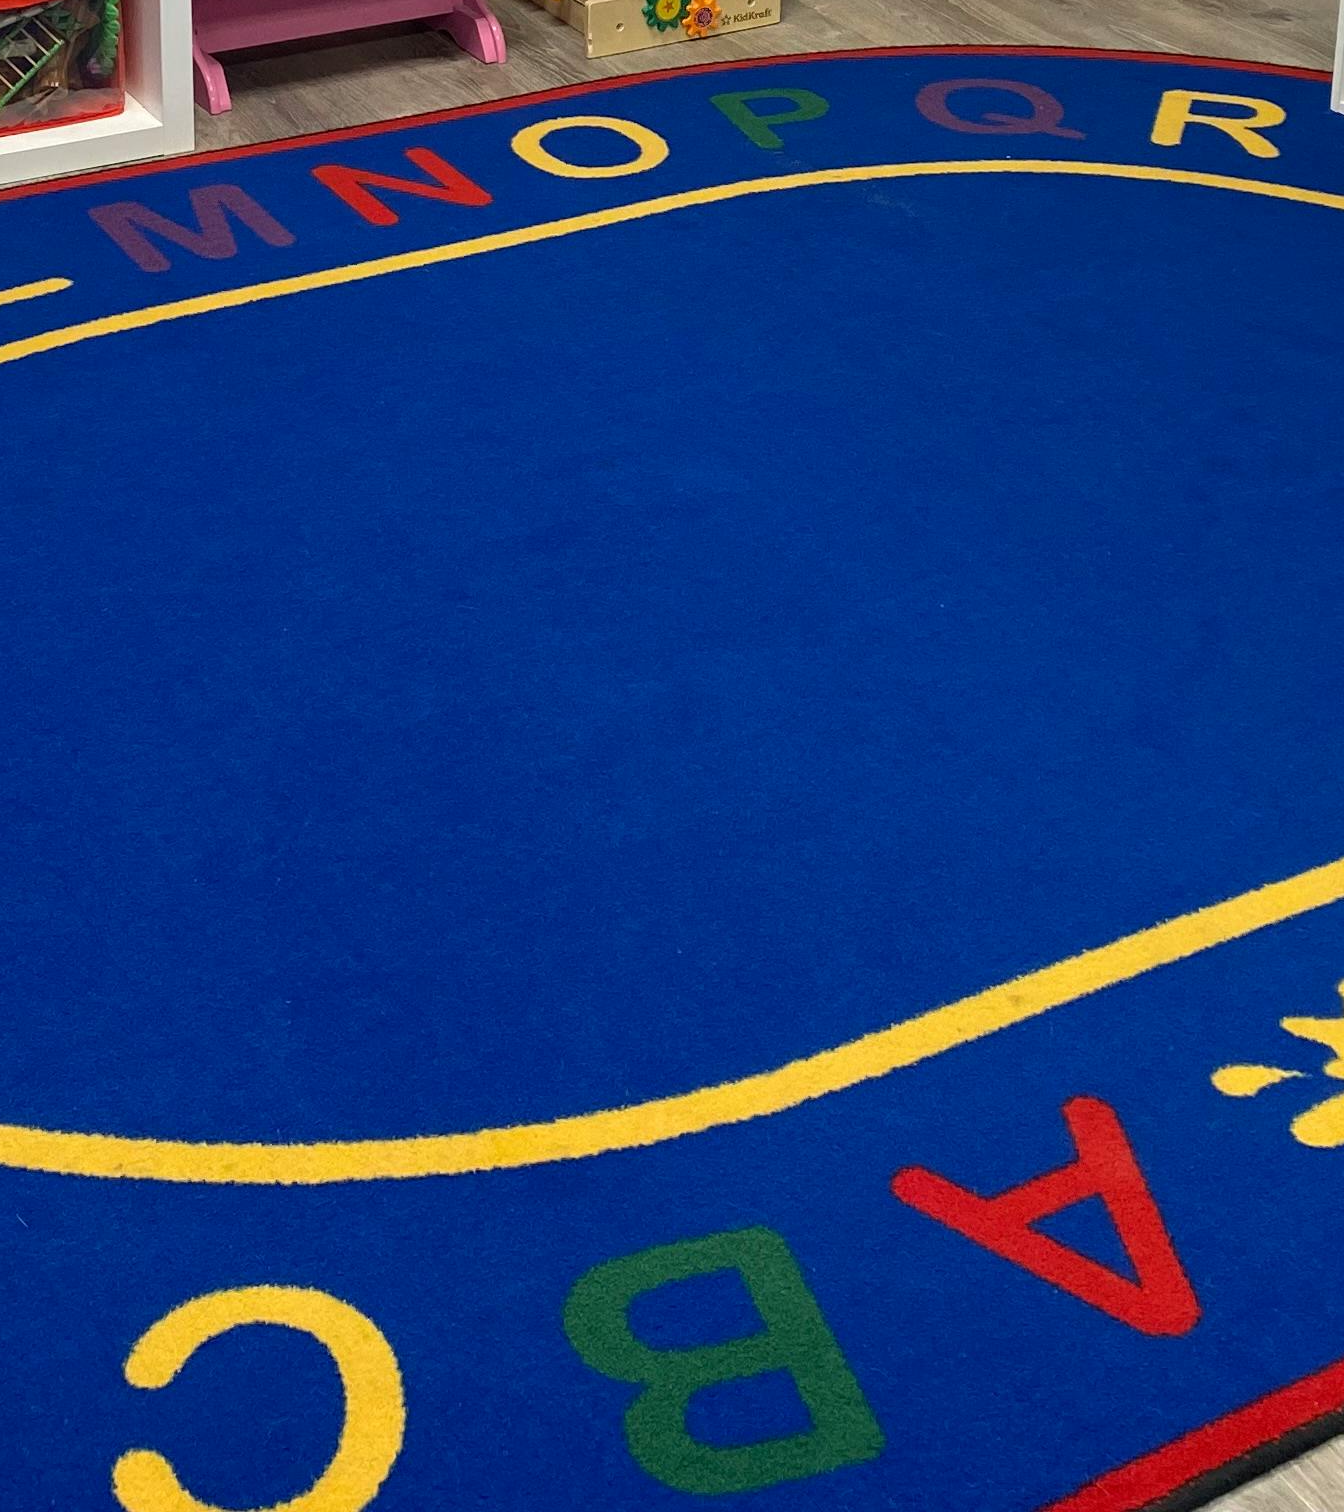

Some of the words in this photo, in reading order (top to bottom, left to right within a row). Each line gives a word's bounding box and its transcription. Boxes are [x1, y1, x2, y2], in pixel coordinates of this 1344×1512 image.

[733, 8, 772, 23] KidKraft
[508, 114, 671, 181] O
[708, 86, 830, 152] P
[914, 78, 1088, 144] Q
[1147, 87, 1289, 161] R
[309, 145, 494, 228] N
[88, 183, 296, 276] M
[891, 1096, 1202, 1336] A
[110, 1284, 408, 1512] C
[561, 1225, 886, 1496] B
